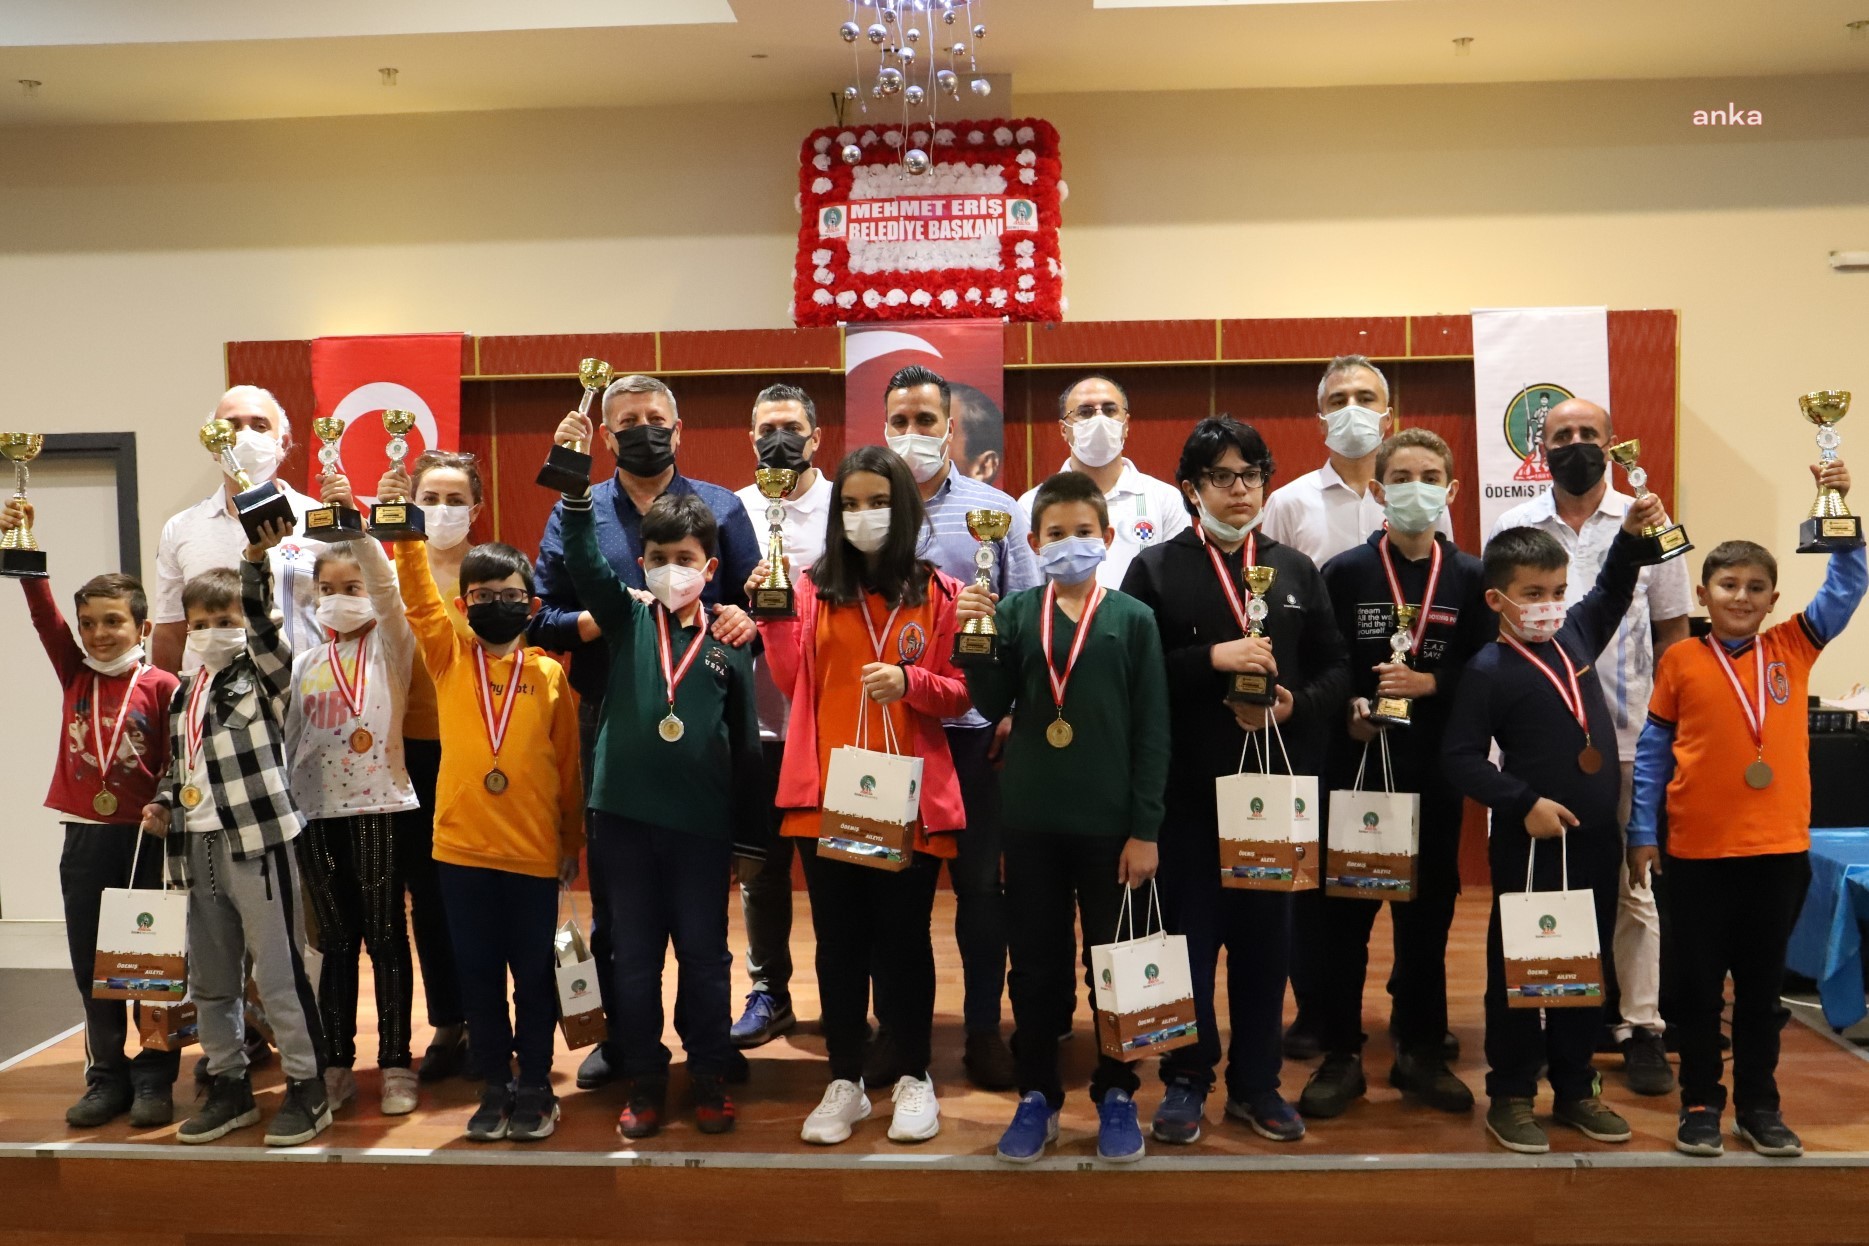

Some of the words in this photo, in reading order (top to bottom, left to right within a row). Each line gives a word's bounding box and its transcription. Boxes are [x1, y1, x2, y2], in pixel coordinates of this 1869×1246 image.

[850, 200, 946, 219] MEHMET
[951, 196, 1003, 217] ERİŞ
[849, 217, 925, 240] BELEDİYE
[928, 218, 1003, 241] BAŞKANI
[303, 690, 360, 730] GIR
